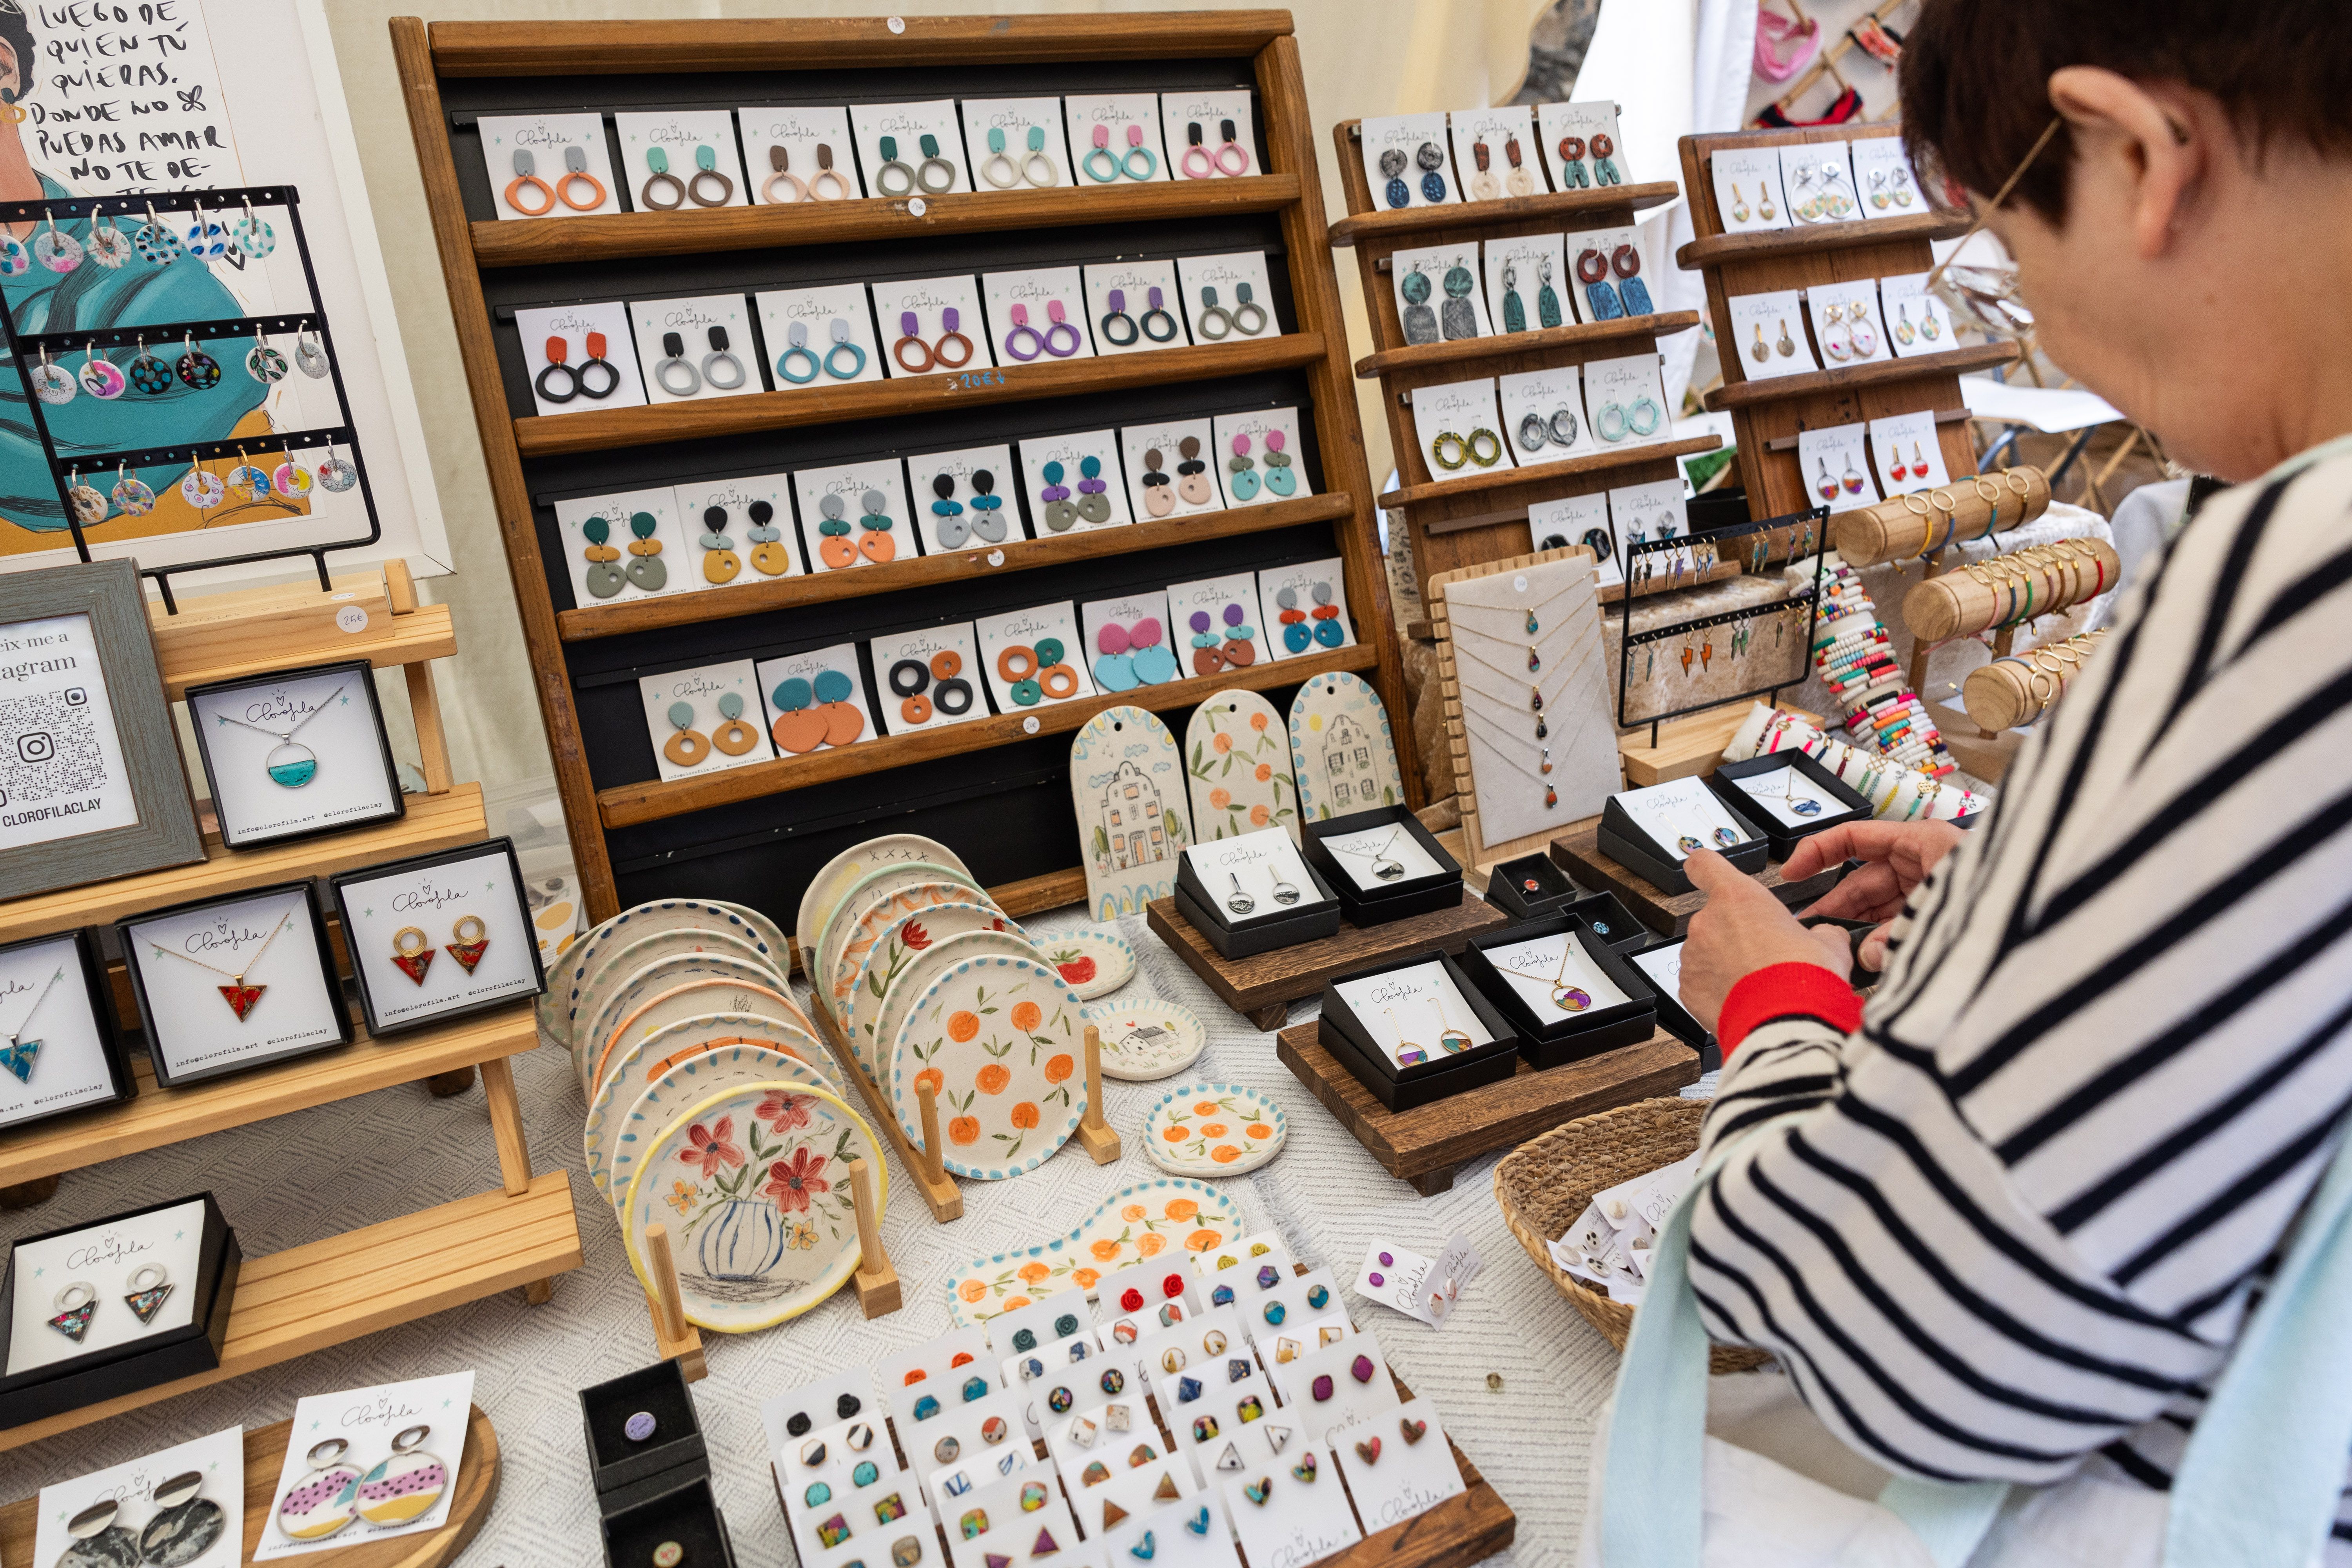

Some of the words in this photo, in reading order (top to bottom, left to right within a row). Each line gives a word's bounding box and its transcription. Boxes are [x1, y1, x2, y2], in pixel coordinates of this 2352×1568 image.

[40, 2, 130, 29] LUEGO
[139, 0, 177, 24] DE
[47, 27, 138, 64] QUIEN
[148, 21, 190, 57] TÚ
[51, 60, 178, 98] QUIERAS.
[30, 101, 121, 130] DONDE
[131, 100, 169, 115] NO
[36, 129, 126, 160] PUEDAS
[140, 125, 227, 151] AMAR
[70, 158, 110, 181] NO
[116, 160, 158, 181] TE
[167, 158, 211, 178] DE-
[960, 372, 995, 388] 20€
[344, 613, 363, 625] 25€
[59, 633, 70, 642] a
[0, 657, 78, 682] agram
[2, 798, 101, 827] CLOROFILACLAY
[237, 815, 315, 835] info@clorofila.art
[324, 801, 383, 818] @clorofilaclay
[393, 889, 468, 911] Clorofila
[185, 930, 267, 953] Clorofila
[385, 994, 460, 1017] info@clorofila.art
[468, 978, 526, 996] @clorofilaclay
[176, 1042, 258, 1067] info@clorofila.art
[267, 1028, 327, 1046] @clorofilaclay
[34, 1083, 103, 1105] @clorofilaclay
